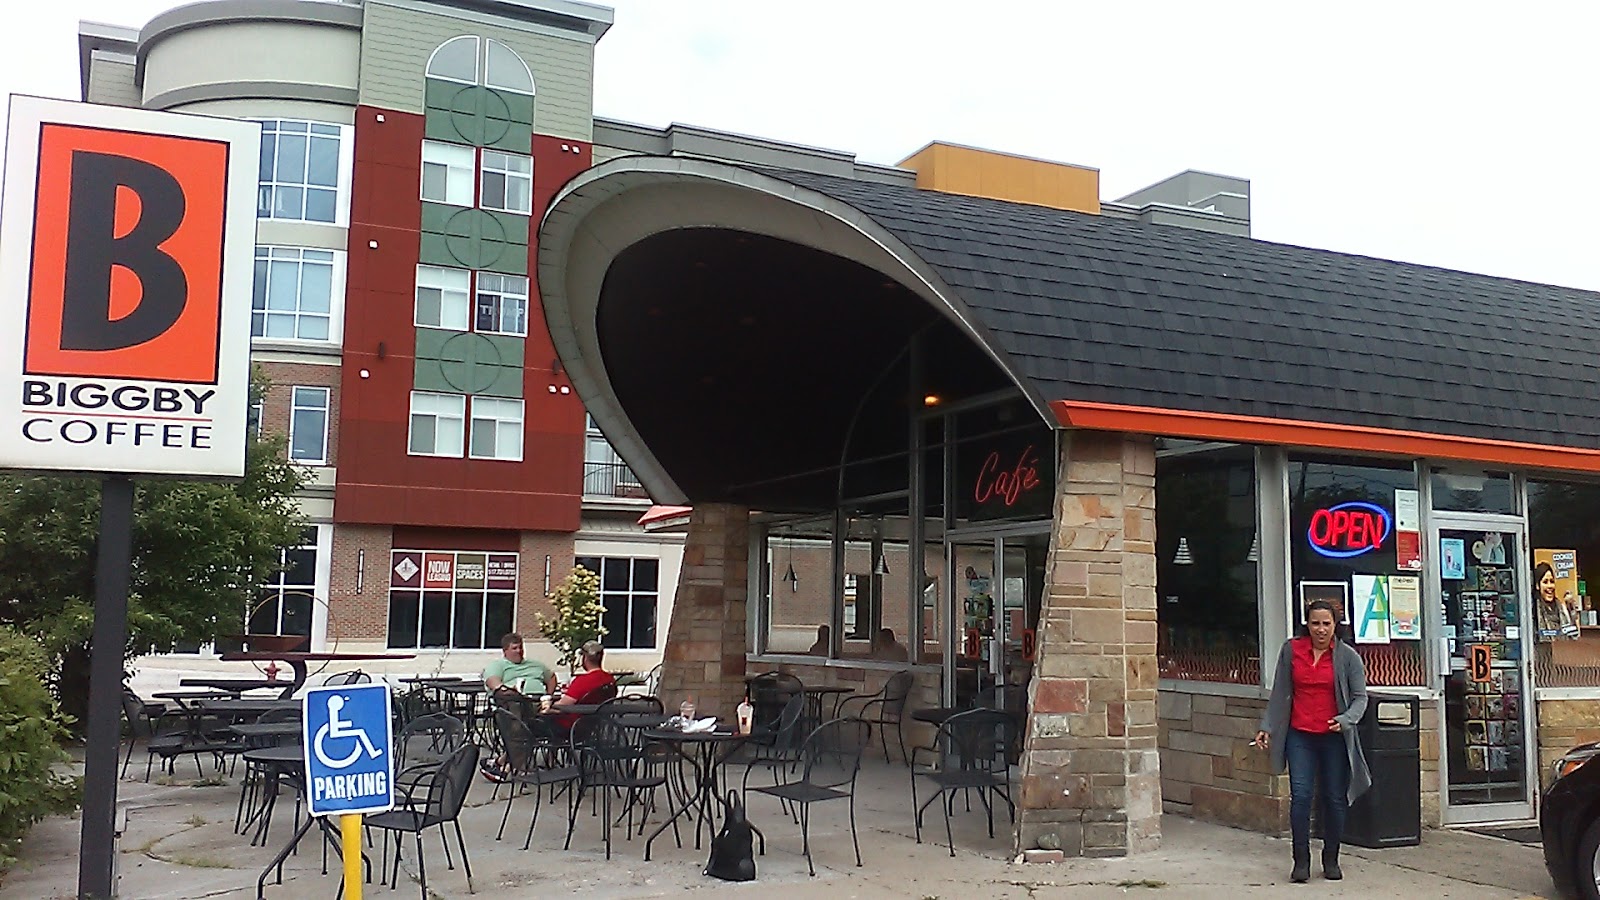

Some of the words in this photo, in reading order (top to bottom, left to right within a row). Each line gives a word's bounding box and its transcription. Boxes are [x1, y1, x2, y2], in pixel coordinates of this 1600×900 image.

[60, 150, 188, 351] B
[22, 380, 215, 415] BIGGBY
[22, 418, 212, 449] COFFEE
[975, 445, 1040, 506] Café
[1310, 509, 1383, 549] OPEN
[429, 561, 450, 573] NOW
[457, 569, 484, 580] SPACES
[1475, 648, 1488, 679] B
[314, 771, 387, 800] PARKING
